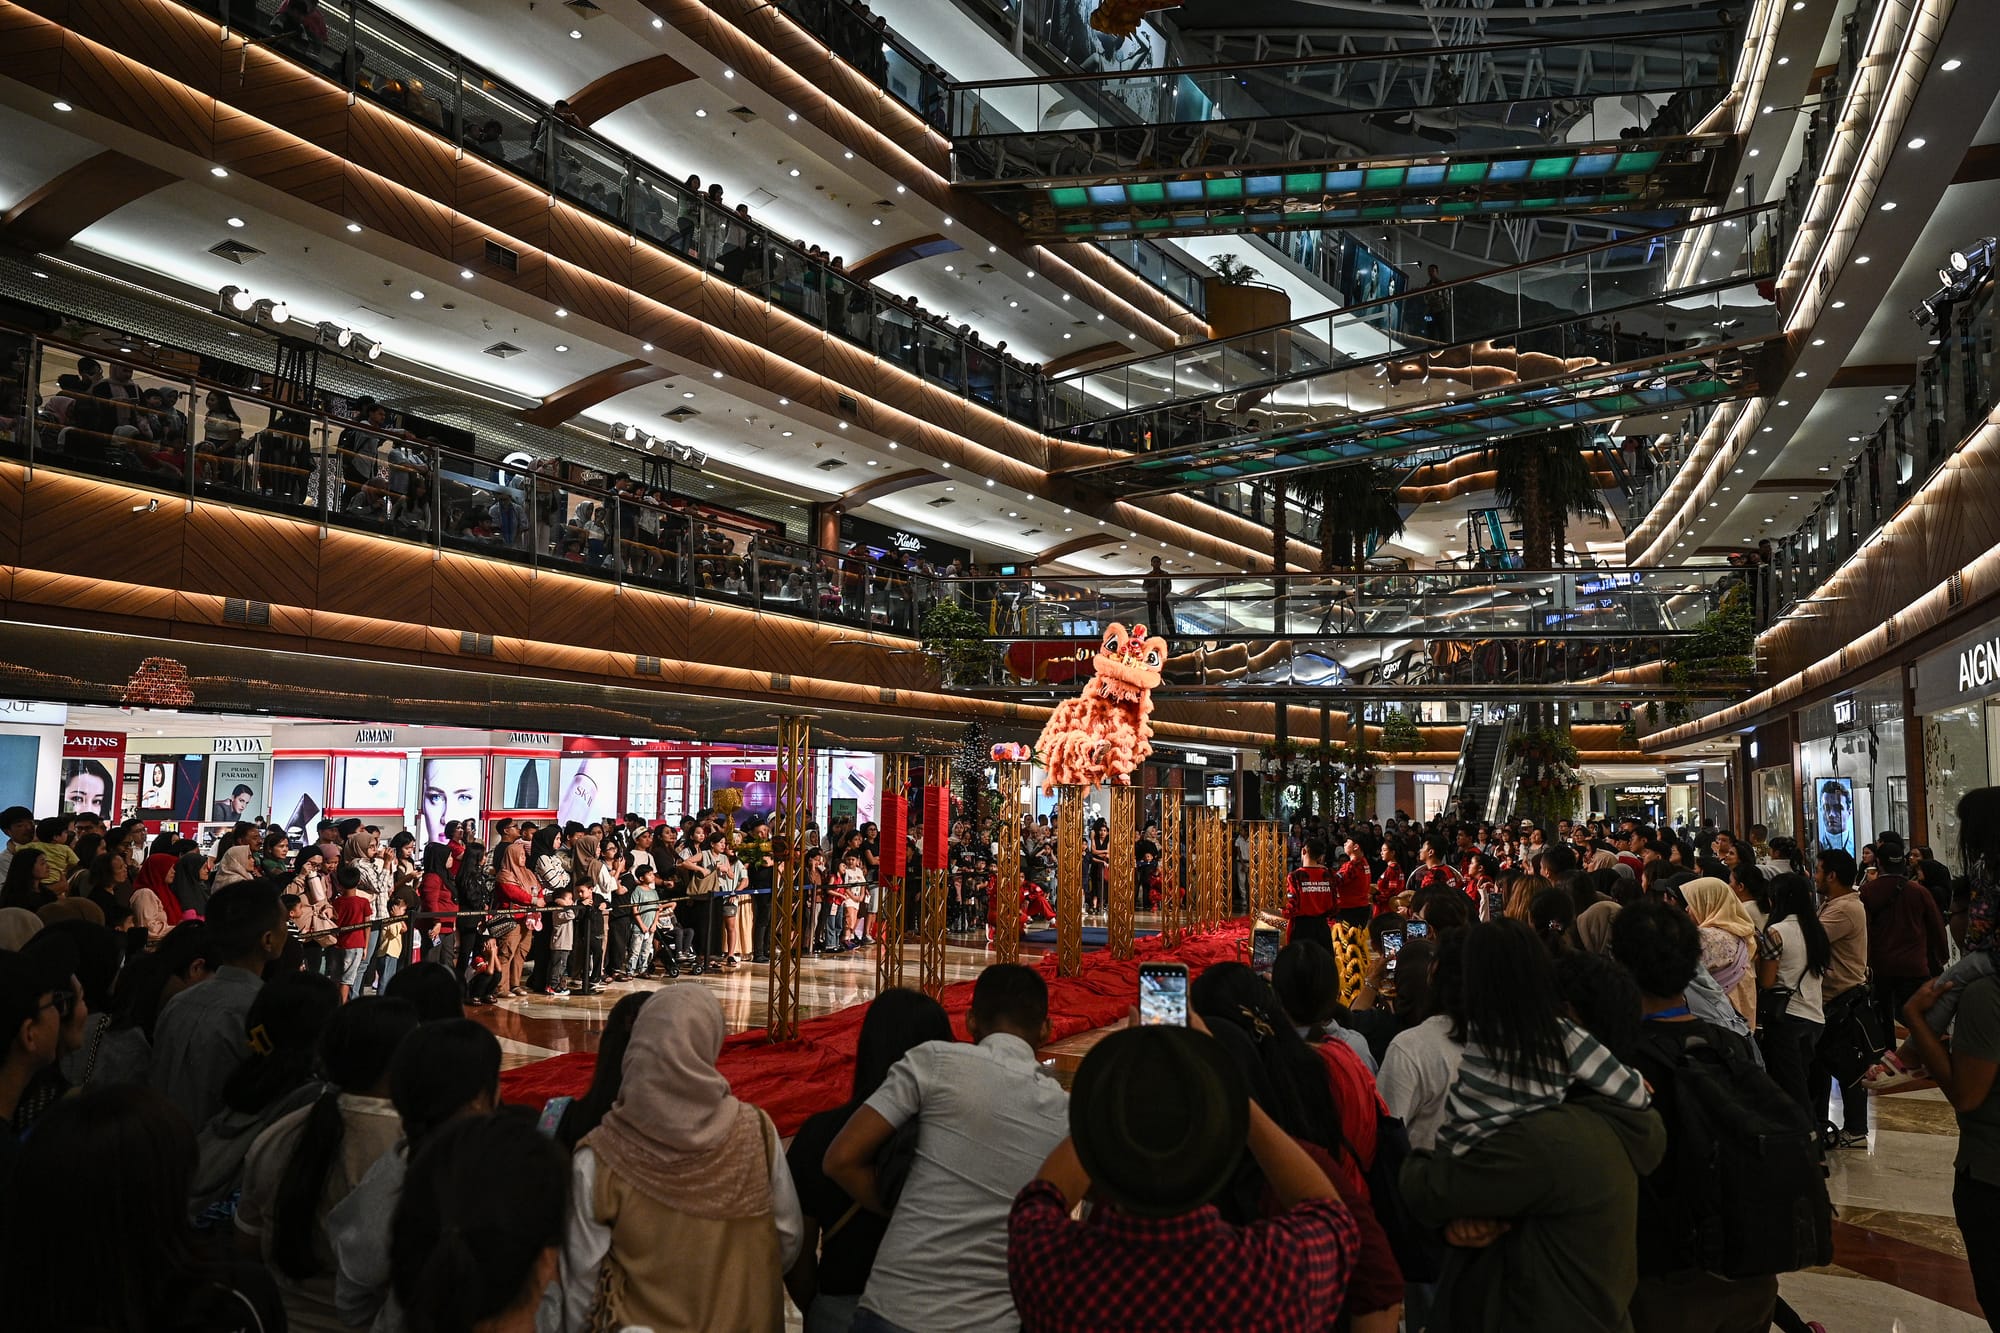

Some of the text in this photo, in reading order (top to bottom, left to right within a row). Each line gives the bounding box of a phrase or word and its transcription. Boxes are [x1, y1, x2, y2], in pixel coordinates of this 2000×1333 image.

[1959, 637, 2000, 692] AIGN
[355, 729, 394, 743] ARMANI
[509, 732, 549, 744] ARMANI
[213, 738, 263, 752] PRADA
